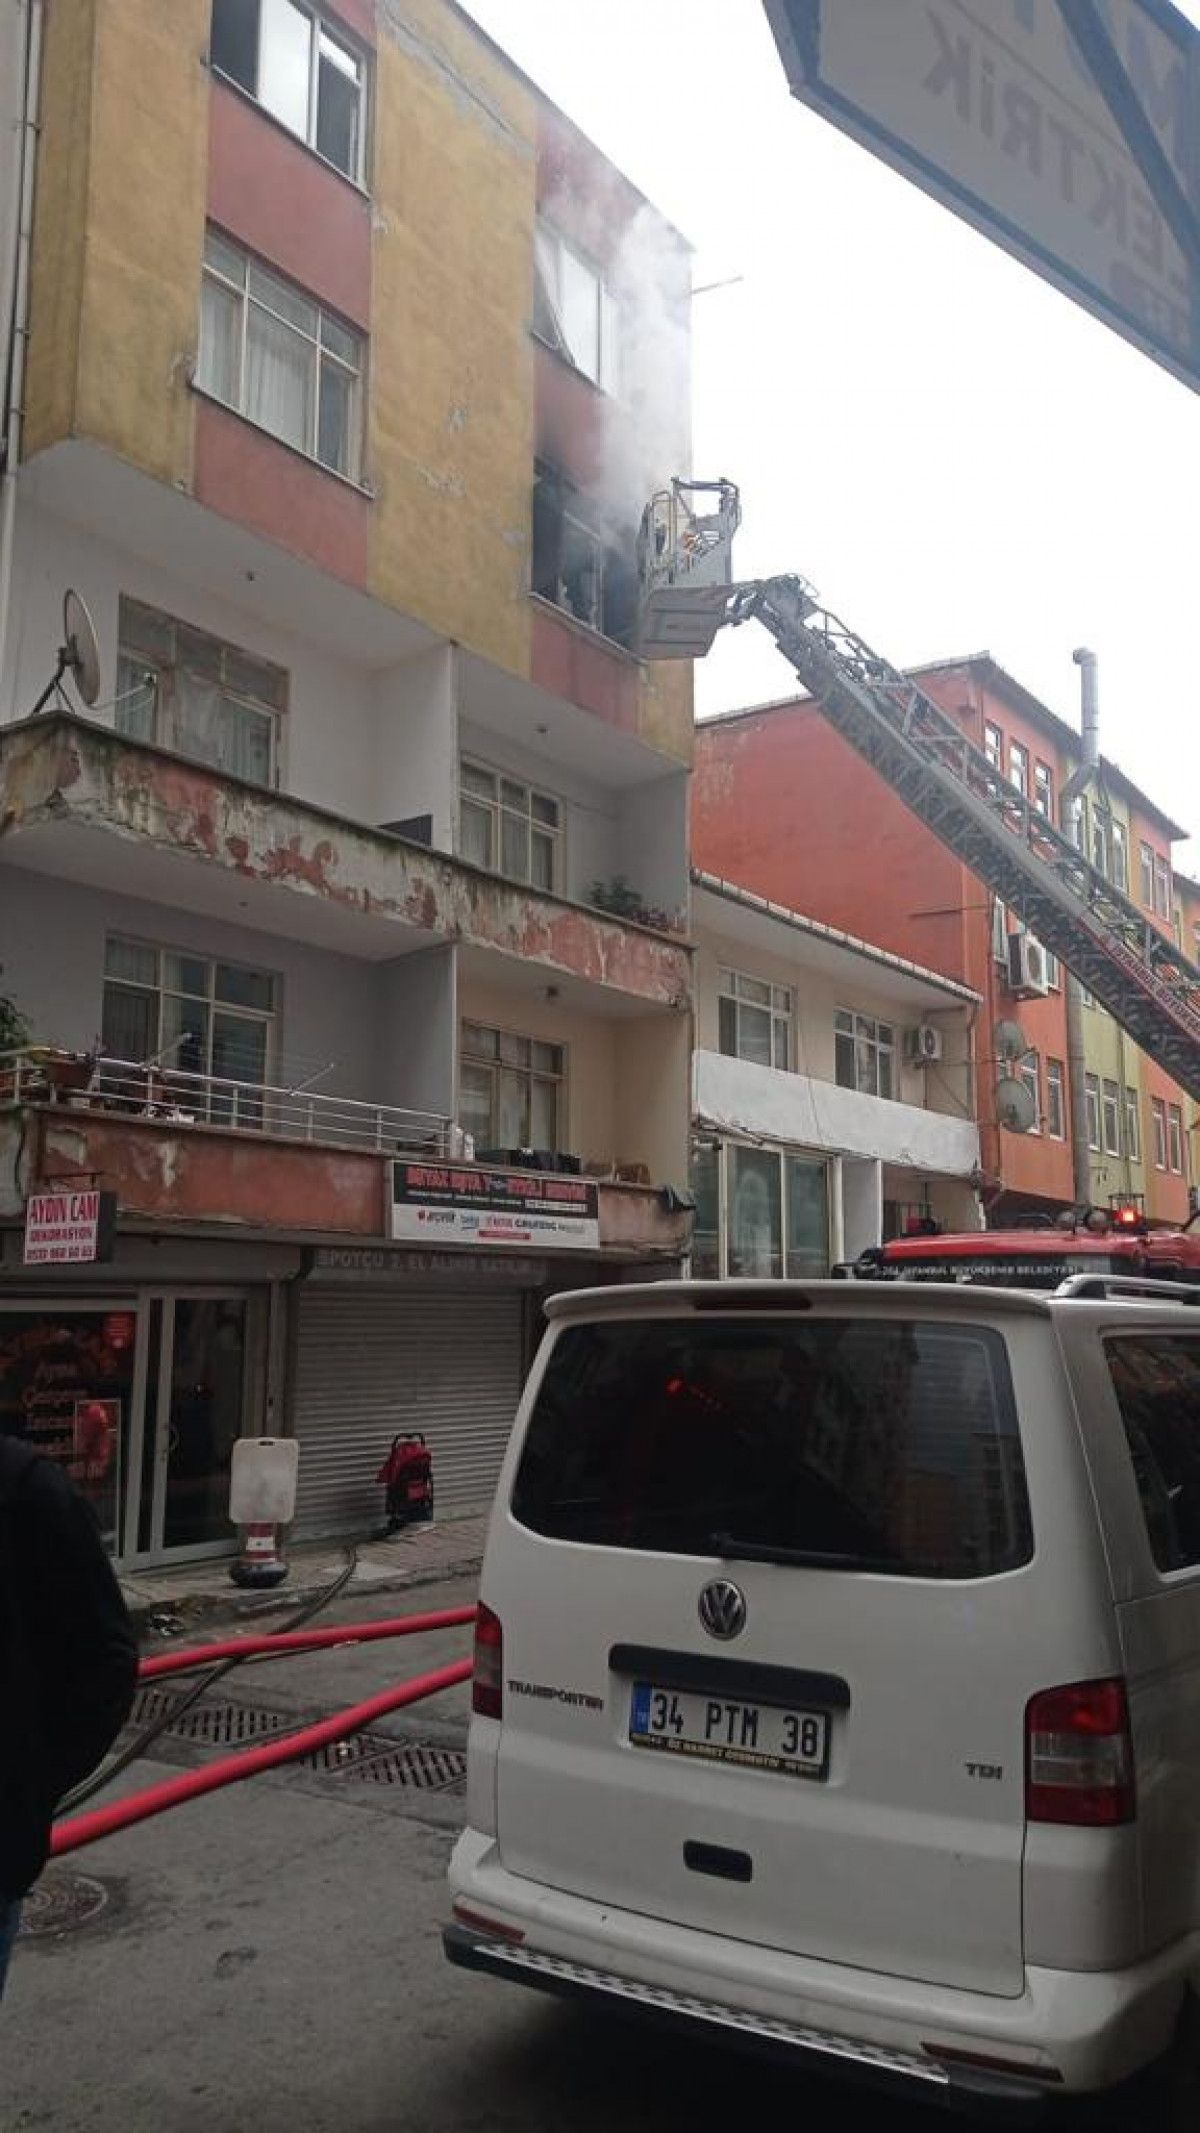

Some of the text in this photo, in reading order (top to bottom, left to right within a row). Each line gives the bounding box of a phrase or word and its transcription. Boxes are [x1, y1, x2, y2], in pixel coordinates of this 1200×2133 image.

[31, 1194, 97, 1224] AYDIN CAM
[507, 1680, 603, 1711] TRANSPORTER
[652, 1693, 817, 1757] 34 PTM 38
[965, 1763, 1002, 1780] TDI
